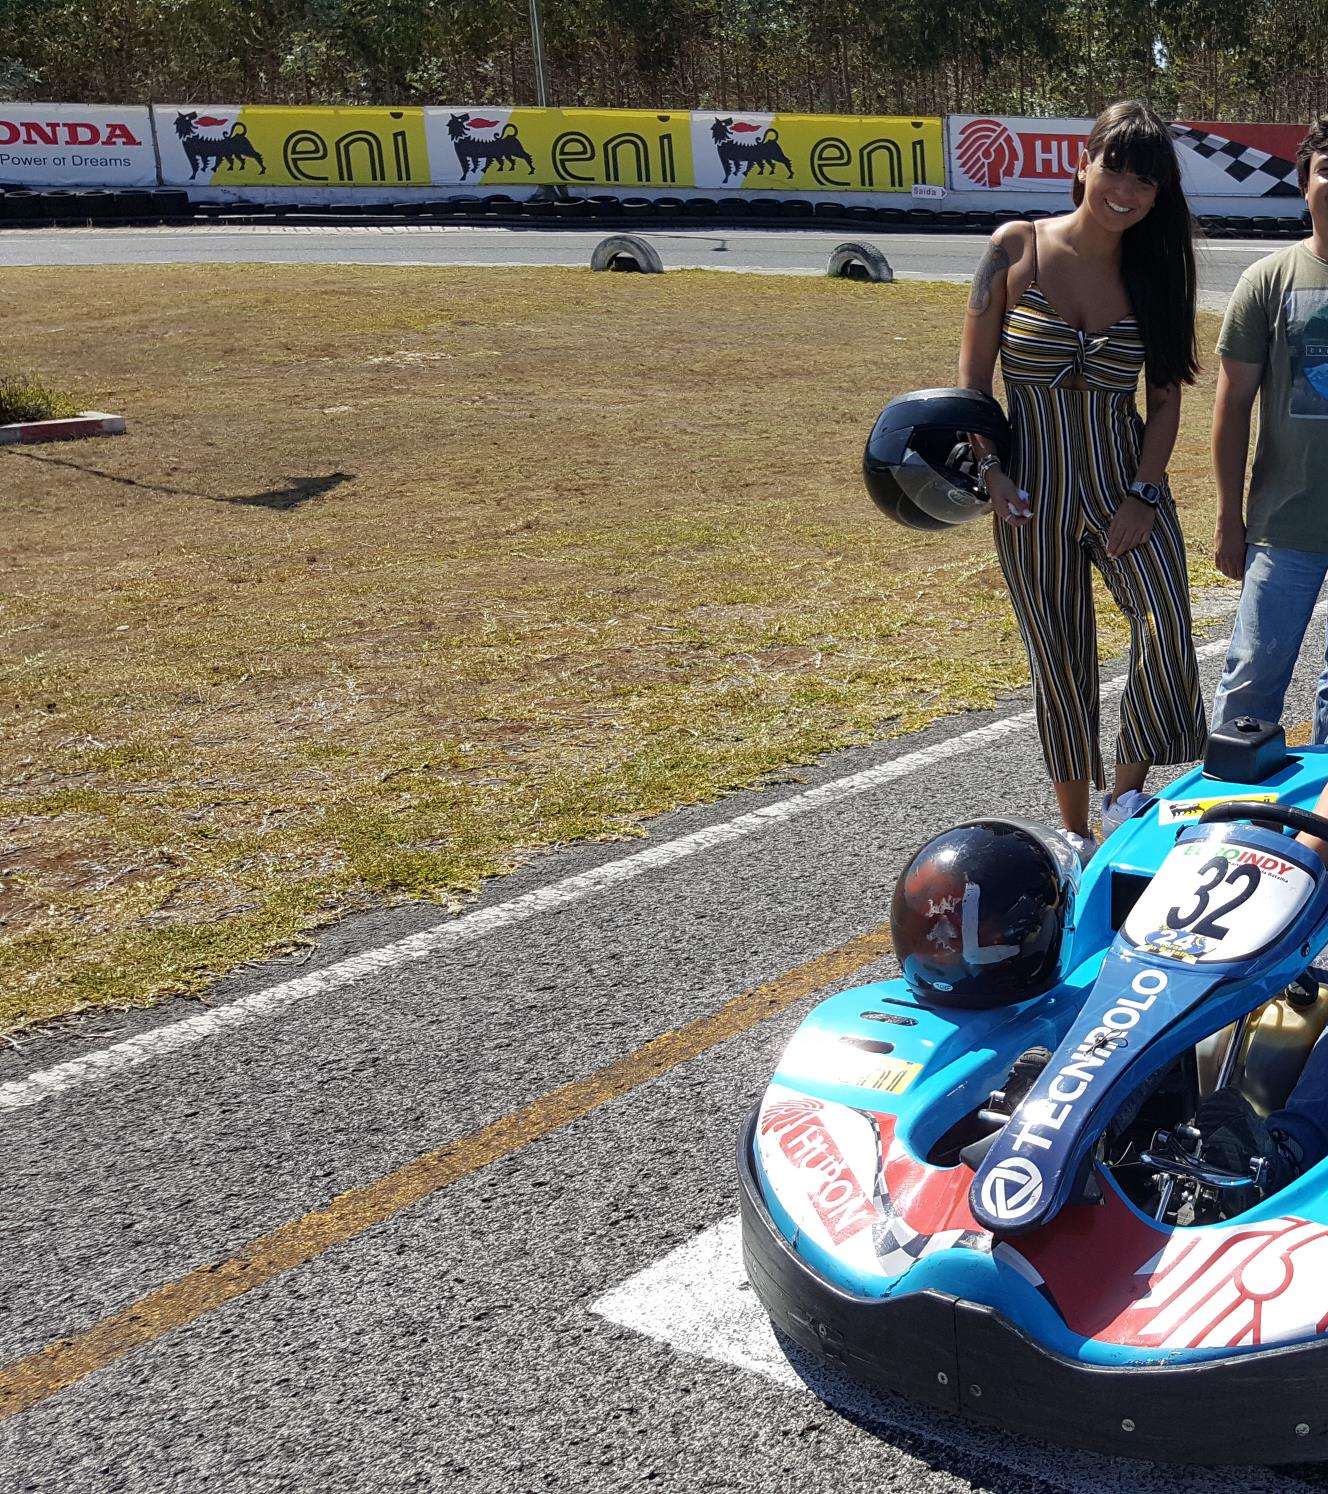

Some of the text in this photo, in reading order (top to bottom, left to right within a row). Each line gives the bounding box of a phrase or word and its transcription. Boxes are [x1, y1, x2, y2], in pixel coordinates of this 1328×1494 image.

[0, 153, 132, 167] Power of Dreams
[283, 111, 412, 182] eni
[551, 114, 677, 183] eni
[809, 120, 928, 187] eni
[1034, 139, 1085, 175] HU
[961, 879, 1021, 965] L
[1166, 855, 1262, 941] 32
[1011, 968, 1170, 1152] TECNIROLO
[786, 1123, 873, 1235] HURON
